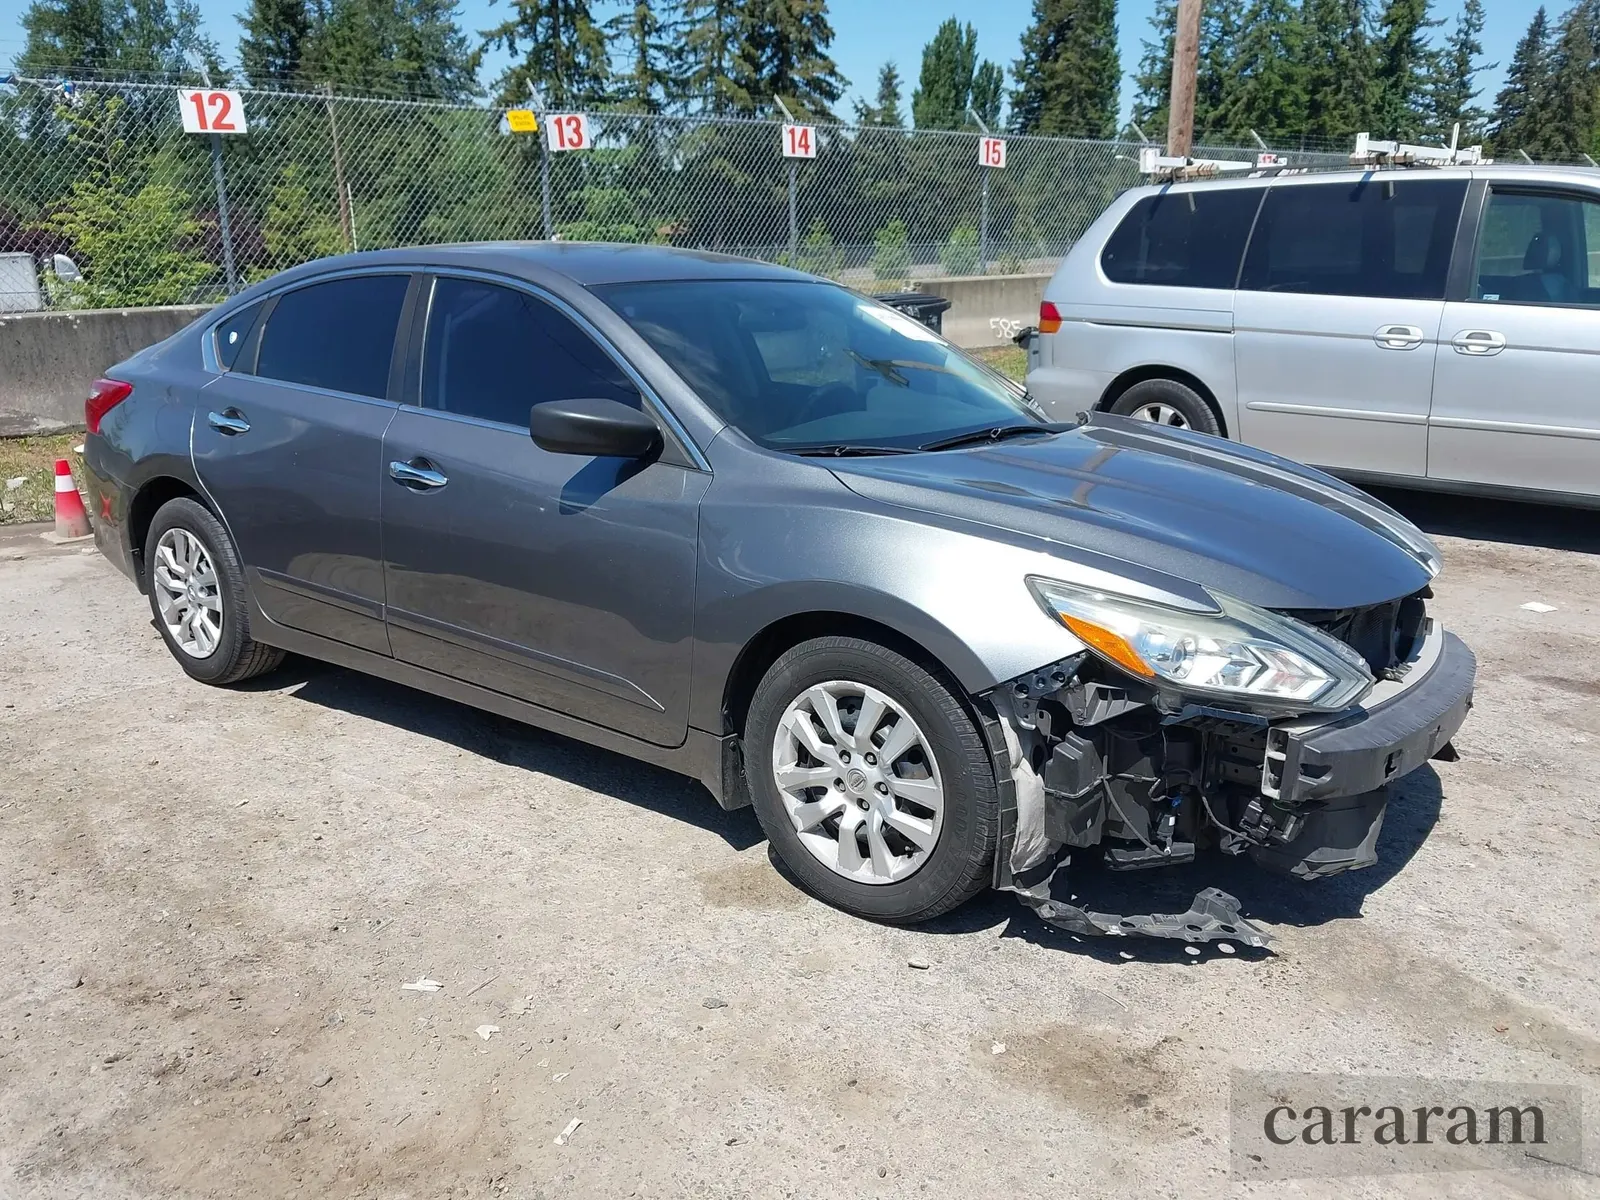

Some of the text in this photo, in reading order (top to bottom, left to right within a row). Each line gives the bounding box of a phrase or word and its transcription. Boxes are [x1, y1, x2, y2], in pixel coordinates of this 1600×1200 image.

[190, 92, 235, 130] 12
[554, 116, 583, 148] 13
[788, 127, 811, 155] 14
[985, 140, 1001, 165] 15
[989, 317, 1023, 338] 585
